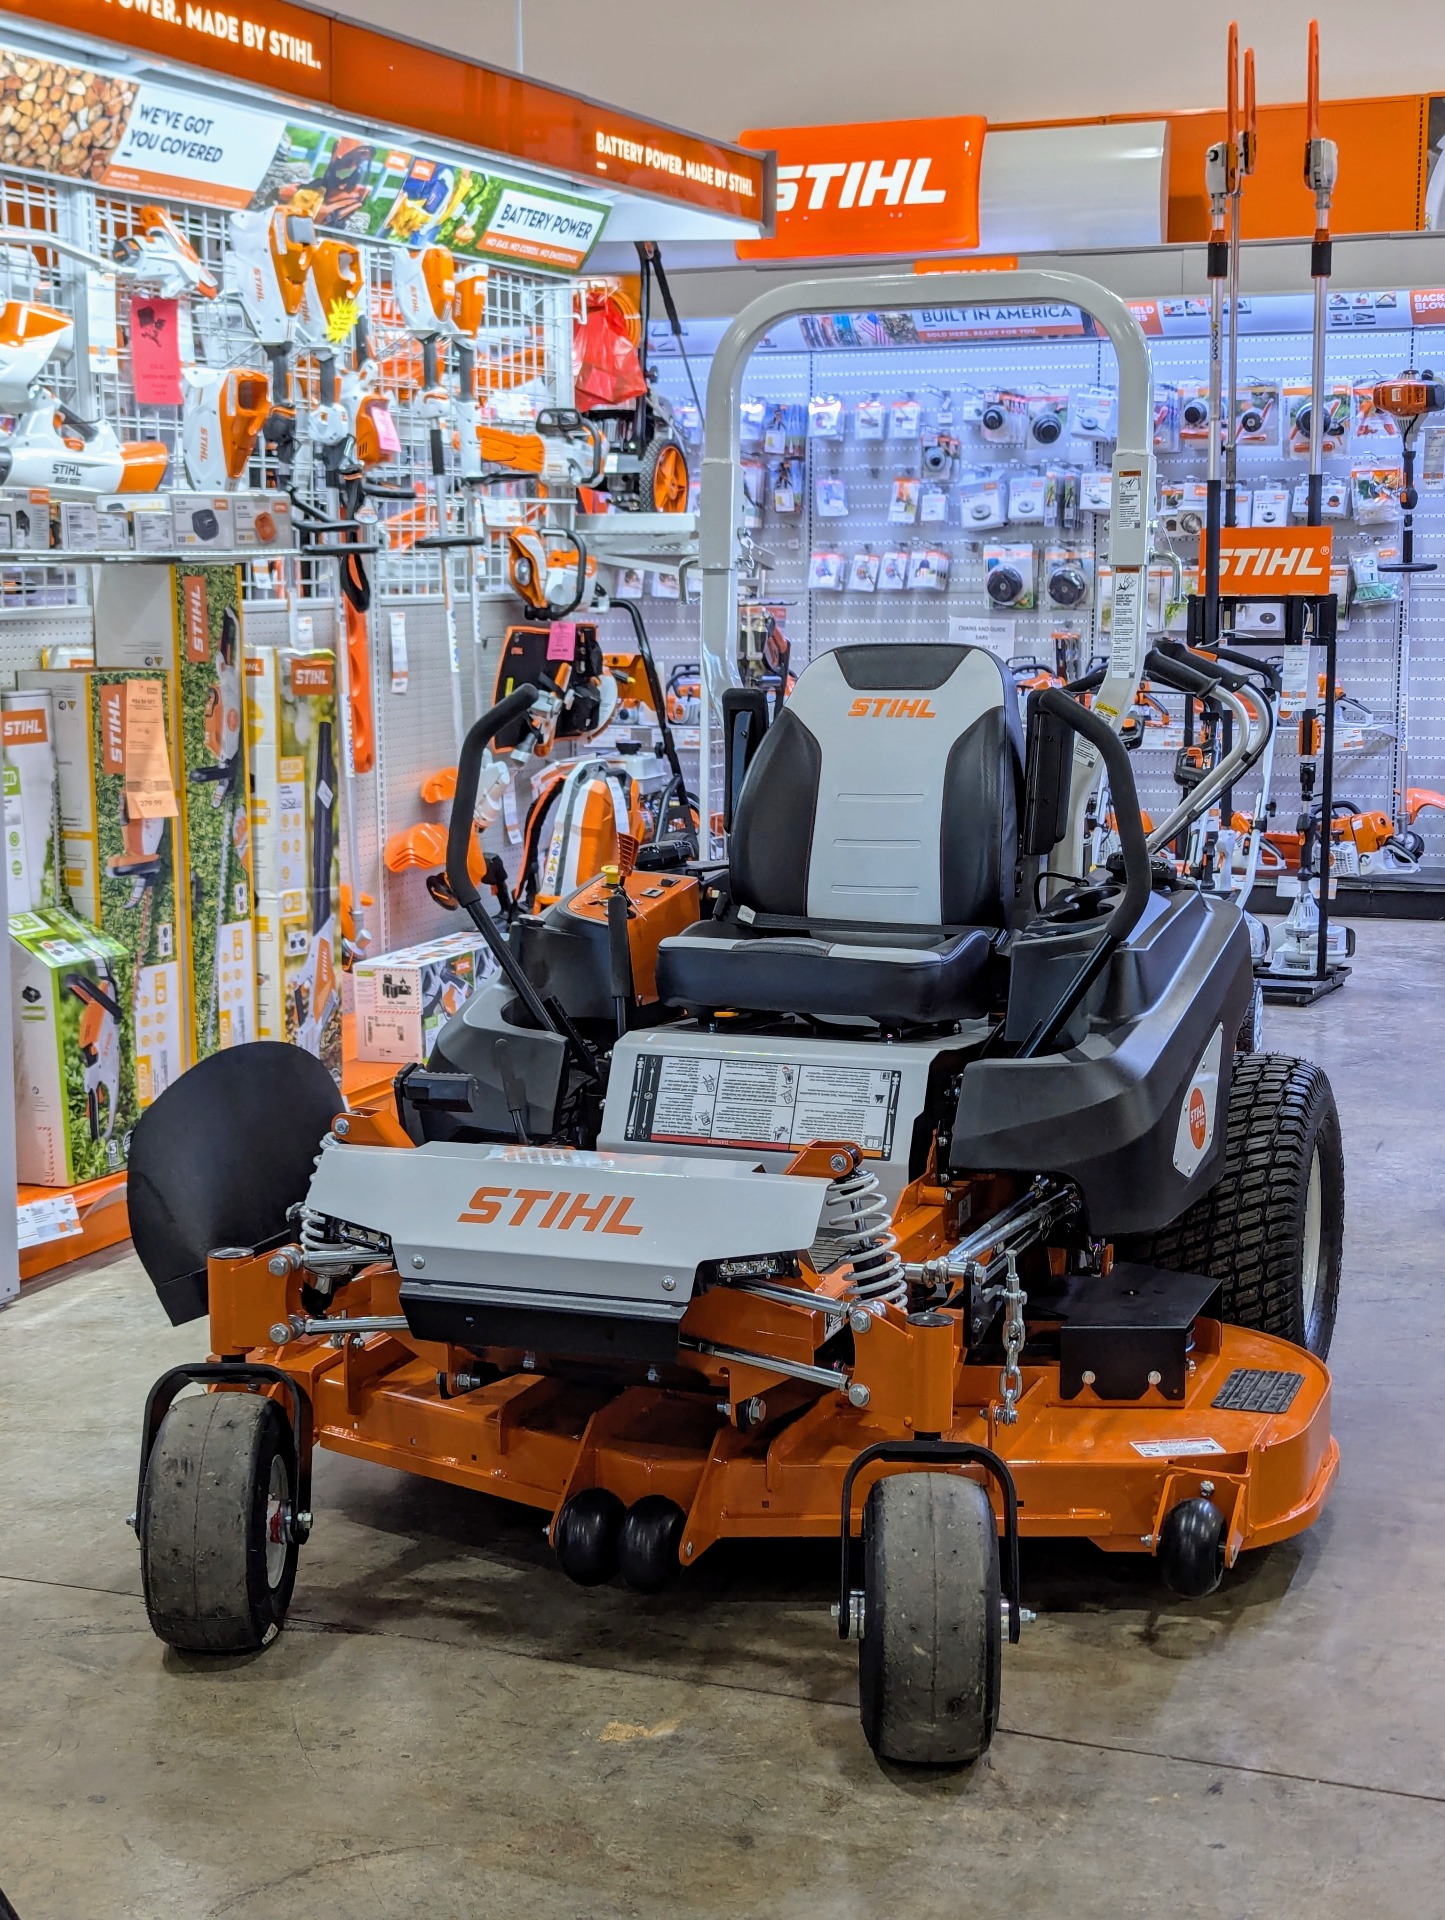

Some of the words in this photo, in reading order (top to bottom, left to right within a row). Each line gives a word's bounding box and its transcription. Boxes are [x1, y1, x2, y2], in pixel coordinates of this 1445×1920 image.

[186, 3, 240, 43] MADE
[242, 21, 266, 51] BY
[269, 31, 322, 70] STIHL.
[140, 104, 183, 129] WE'VE
[184, 115, 215, 136] GOT
[129, 129, 160, 150] YOU
[160, 136, 223, 163] COVERED
[596, 132, 644, 164] BATTERY
[645, 147, 685, 177] POWER.
[686, 160, 714, 186] MADE
[715, 168, 728, 189] BY
[776, 157, 947, 212] STIHL
[501, 203, 554, 231] BATTERY
[551, 215, 593, 240] POWER
[253, 267, 264, 303] STIHL
[922, 309, 967, 323] BUILT
[973, 308, 991, 321] IN
[995, 305, 1073, 321] AMERICA
[973, 329, 1000, 337] READY
[1001, 328, 1018, 336] FOR
[200, 426, 208, 463] STIHL
[52, 464, 82, 476] STIHL
[187, 585, 204, 653] STIHL
[295, 669, 328, 685] STIHL
[848, 697, 936, 718] STIHL
[4, 720, 43, 737] STIHL
[108, 693, 123, 764] STIHL
[1190, 1103, 1205, 1124] STIHL
[457, 1186, 643, 1236] STIHL
